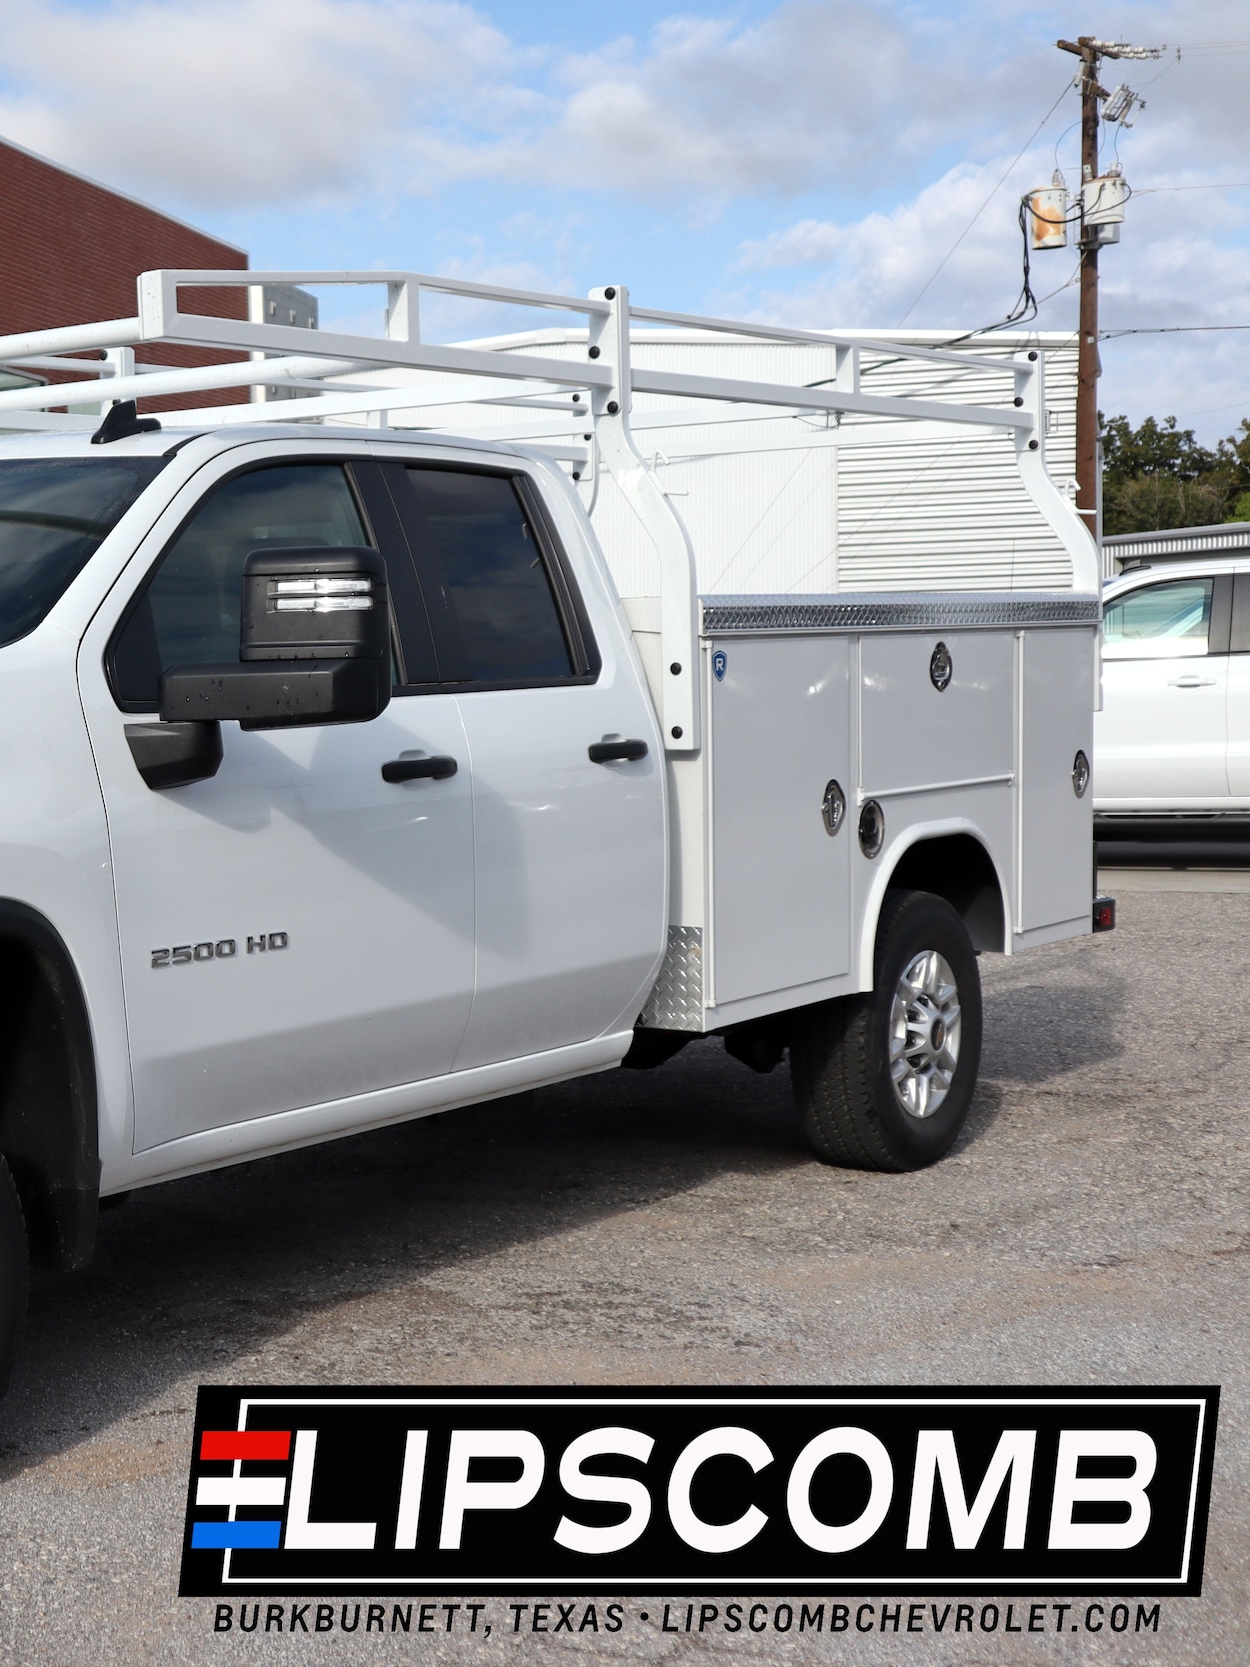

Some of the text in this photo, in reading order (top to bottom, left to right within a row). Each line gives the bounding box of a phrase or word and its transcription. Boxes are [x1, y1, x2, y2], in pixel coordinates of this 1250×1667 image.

[715, 657, 724, 671] R
[150, 931, 288, 969] 2500 HD
